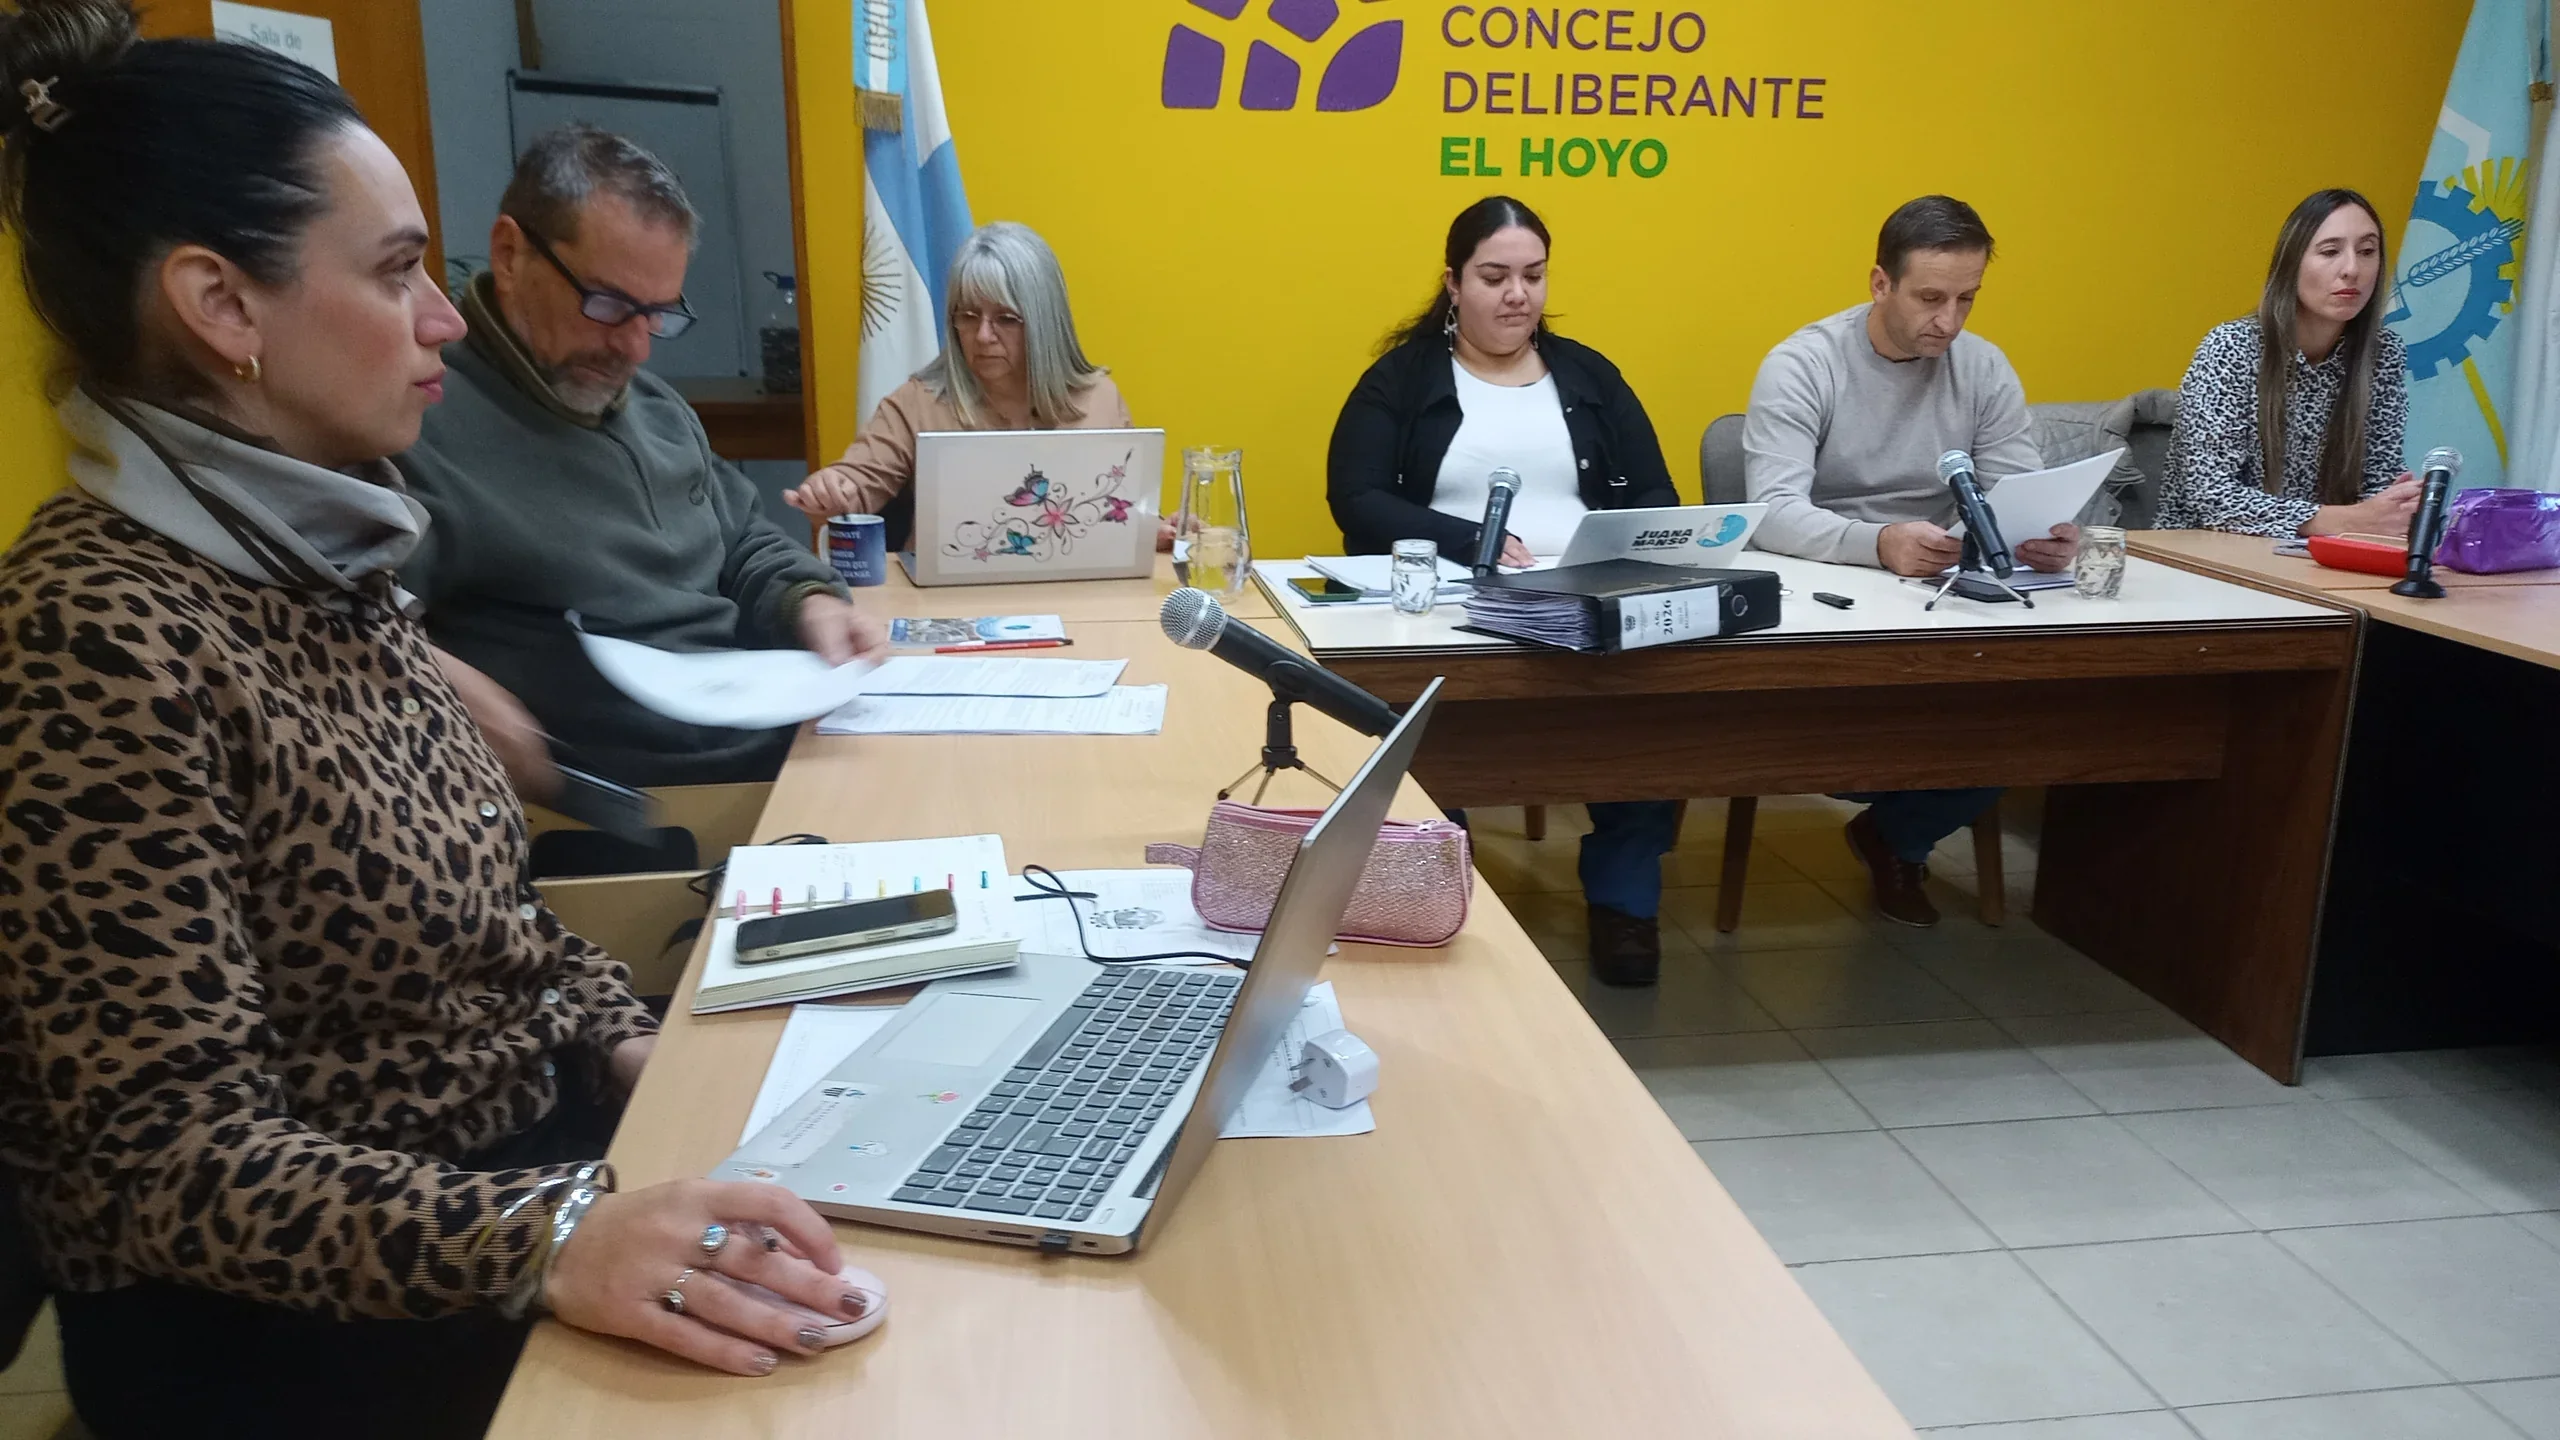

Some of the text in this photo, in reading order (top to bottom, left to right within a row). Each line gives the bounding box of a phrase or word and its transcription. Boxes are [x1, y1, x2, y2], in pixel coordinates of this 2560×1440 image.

[250, 23, 280, 46] Sala
[1442, 6, 1705, 53] CONCEJO
[1444, 72, 1825, 118] DELIBERANTE
[1442, 137, 1667, 177] EL HOYO
[1632, 537, 1689, 547] MANSO
[1636, 529, 1693, 538] JUANA
[1663, 600, 1673, 636] 2026
